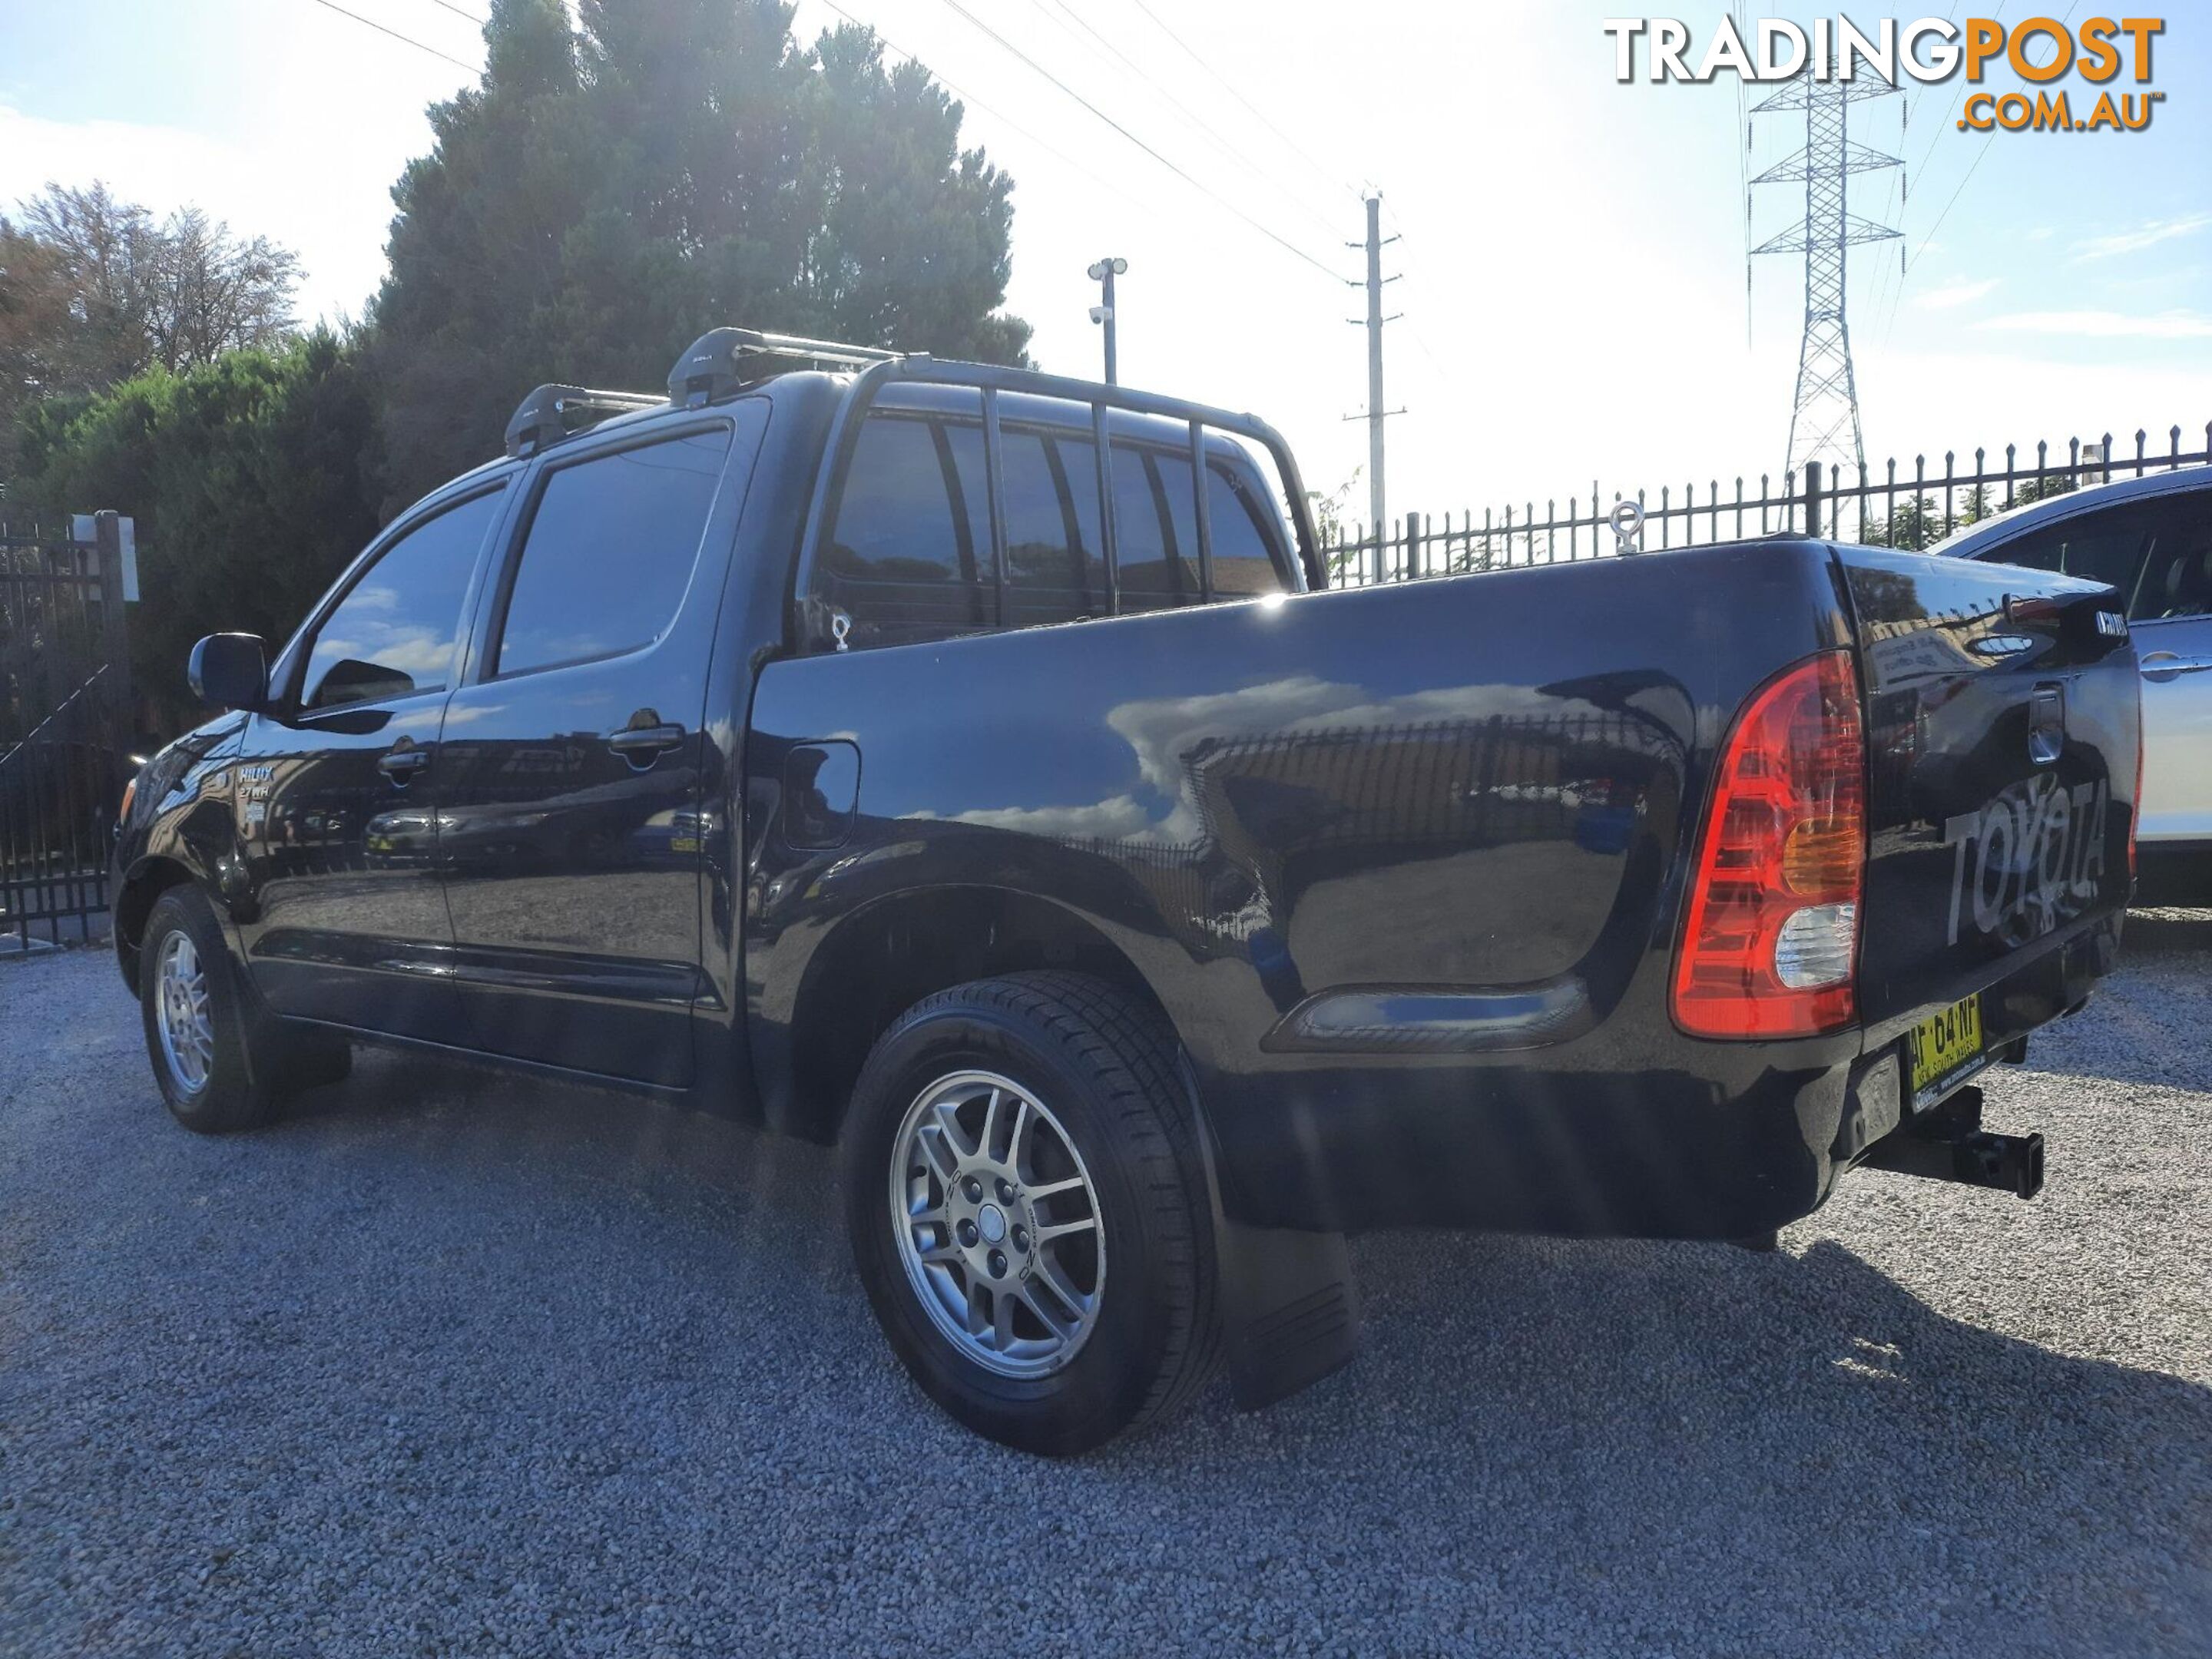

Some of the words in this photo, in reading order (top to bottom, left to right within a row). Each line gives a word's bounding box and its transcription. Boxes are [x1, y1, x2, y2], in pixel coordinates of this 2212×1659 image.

[240, 767, 274, 783] HILUX
[1945, 779, 2108, 945] TOYOTA
[1932, 1055, 1953, 1075] SOUTH
